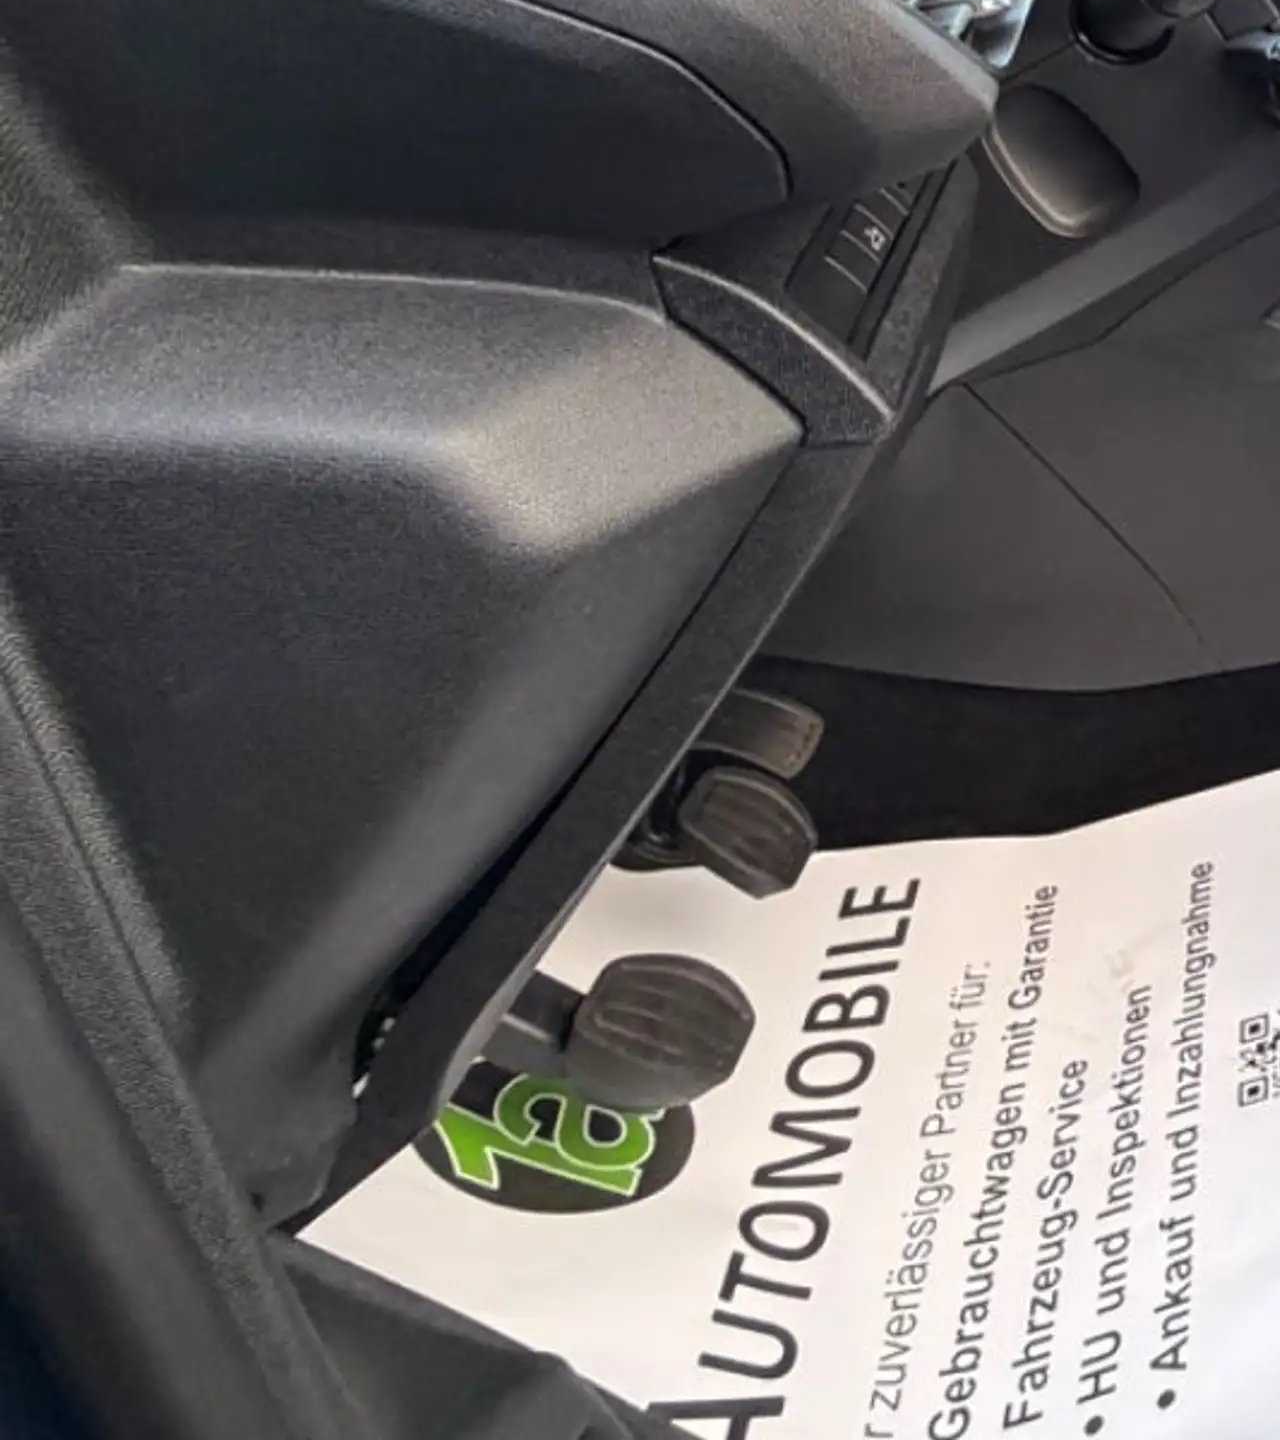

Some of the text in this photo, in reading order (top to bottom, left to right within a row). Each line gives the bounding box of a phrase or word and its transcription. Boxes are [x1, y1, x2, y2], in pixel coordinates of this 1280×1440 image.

[921, 1021, 979, 1138] Partner
[927, 885, 1059, 1440] Gebrauchtwagen mit Garantie
[948, 960, 992, 1013] für:
[1148, 861, 1217, 1371] Ankauf und Inzahlungnahme
[868, 1146, 955, 1413] zuverlässiger
[1002, 1059, 1089, 1431] Fahrzeug-Service
[1077, 984, 1153, 1405] HU und Inspektionen
